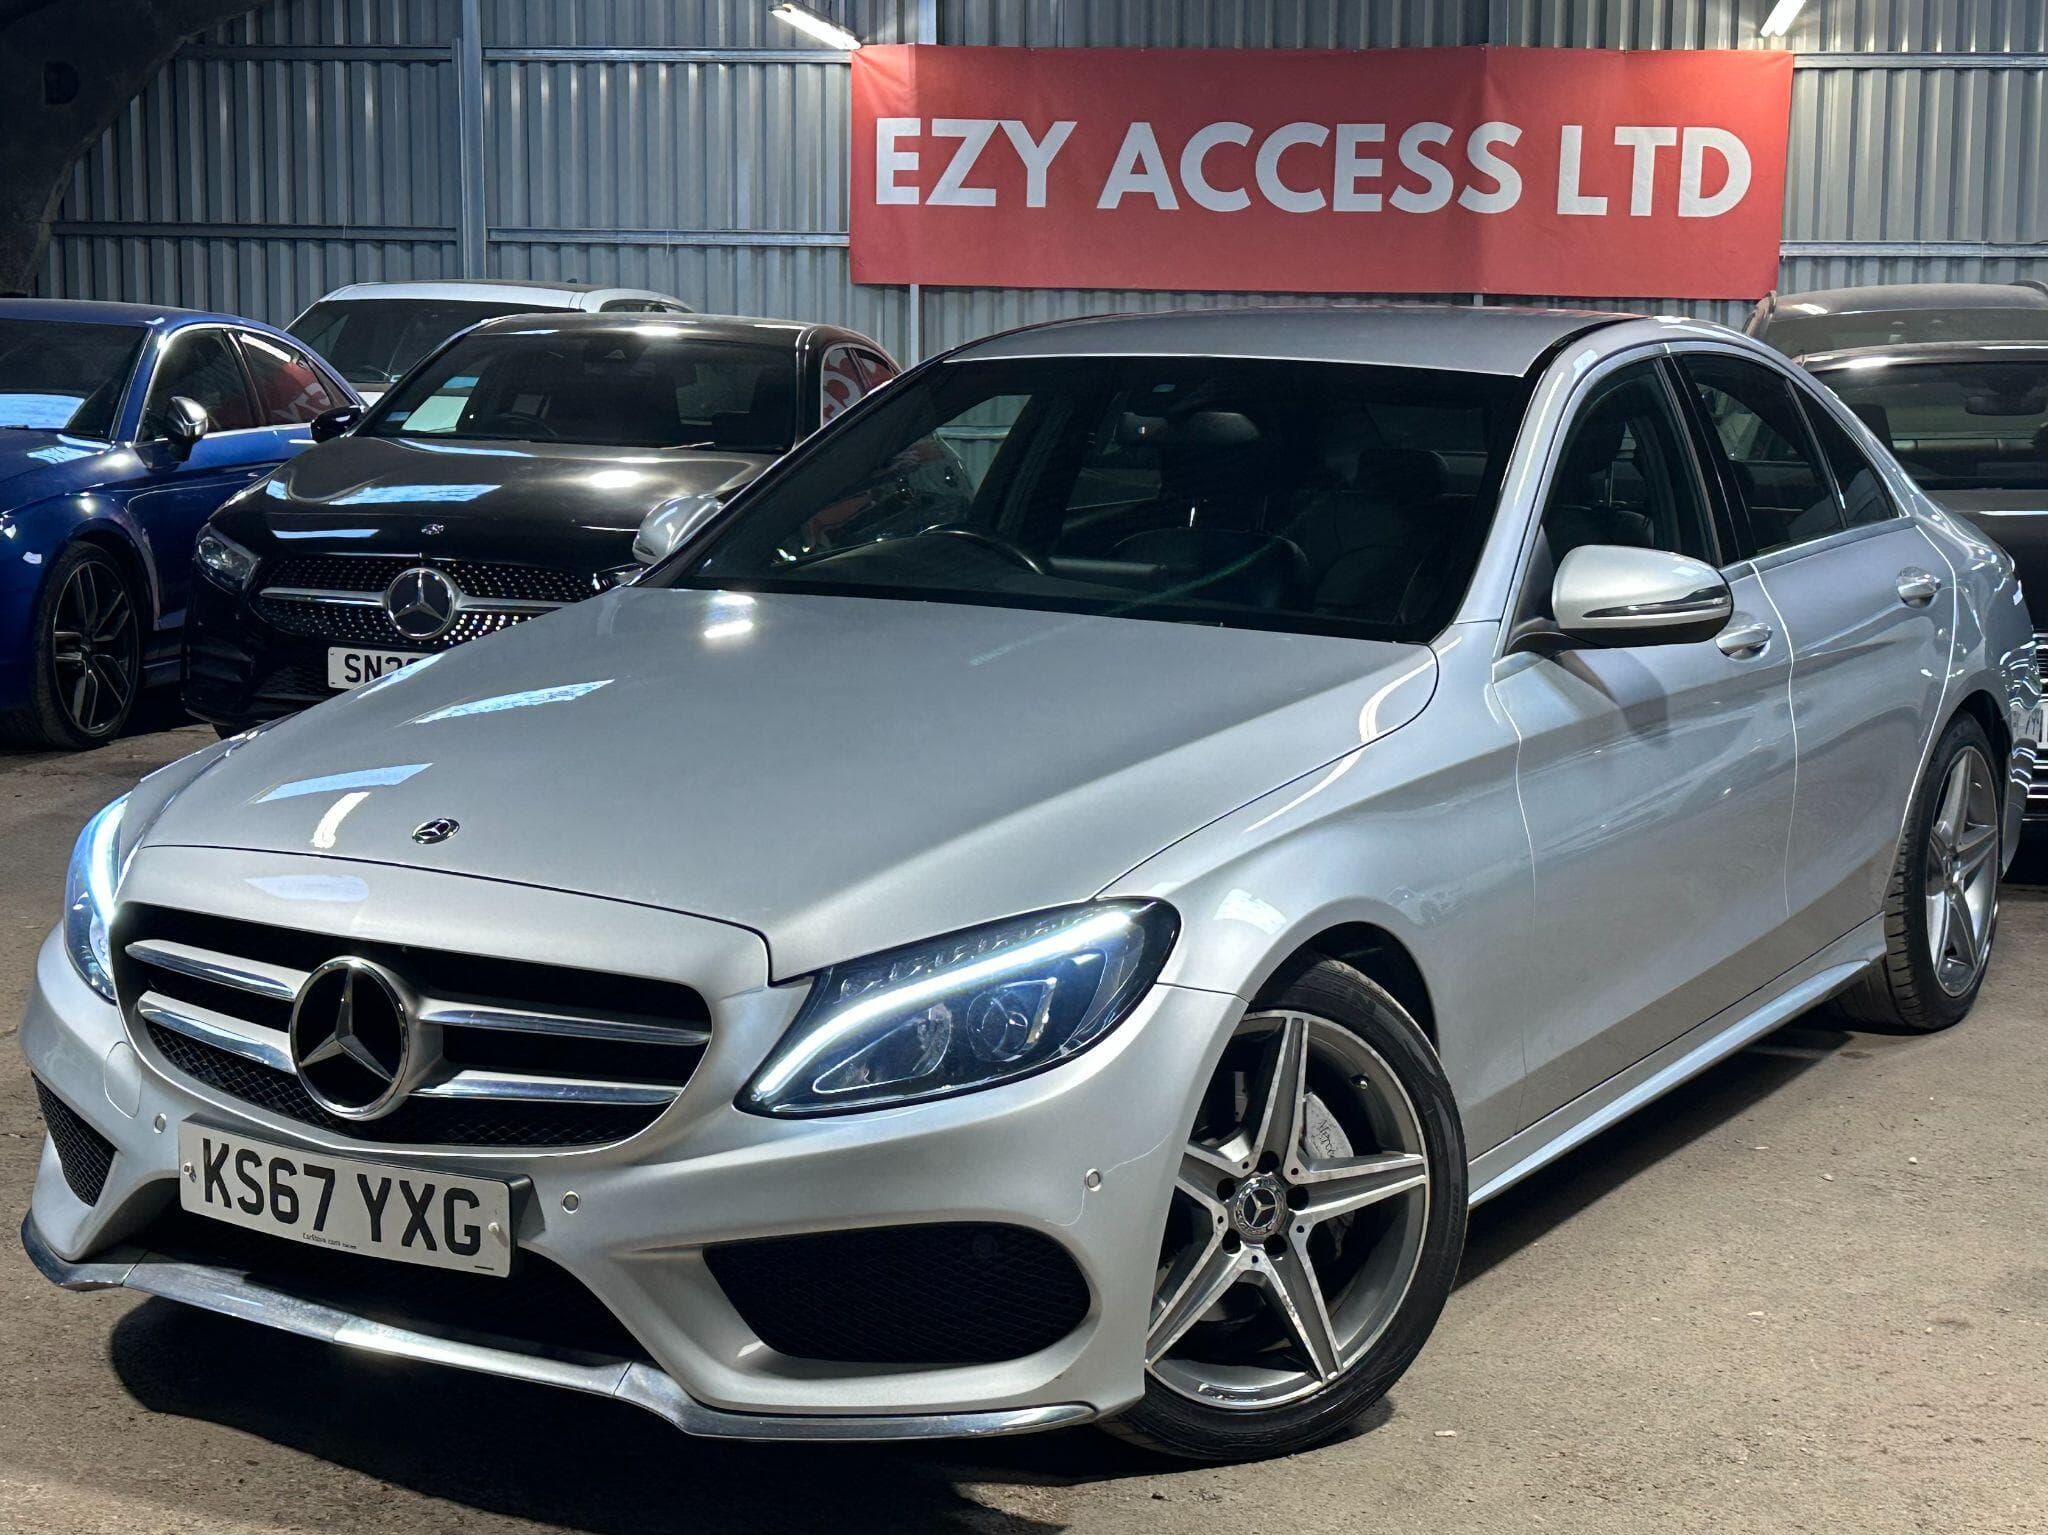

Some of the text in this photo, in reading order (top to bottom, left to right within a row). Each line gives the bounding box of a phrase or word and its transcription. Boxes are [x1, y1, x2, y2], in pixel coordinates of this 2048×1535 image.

[875, 117, 1752, 217] EZY ACCESS LTD
[202, 1137, 482, 1257] KS67 YXG
